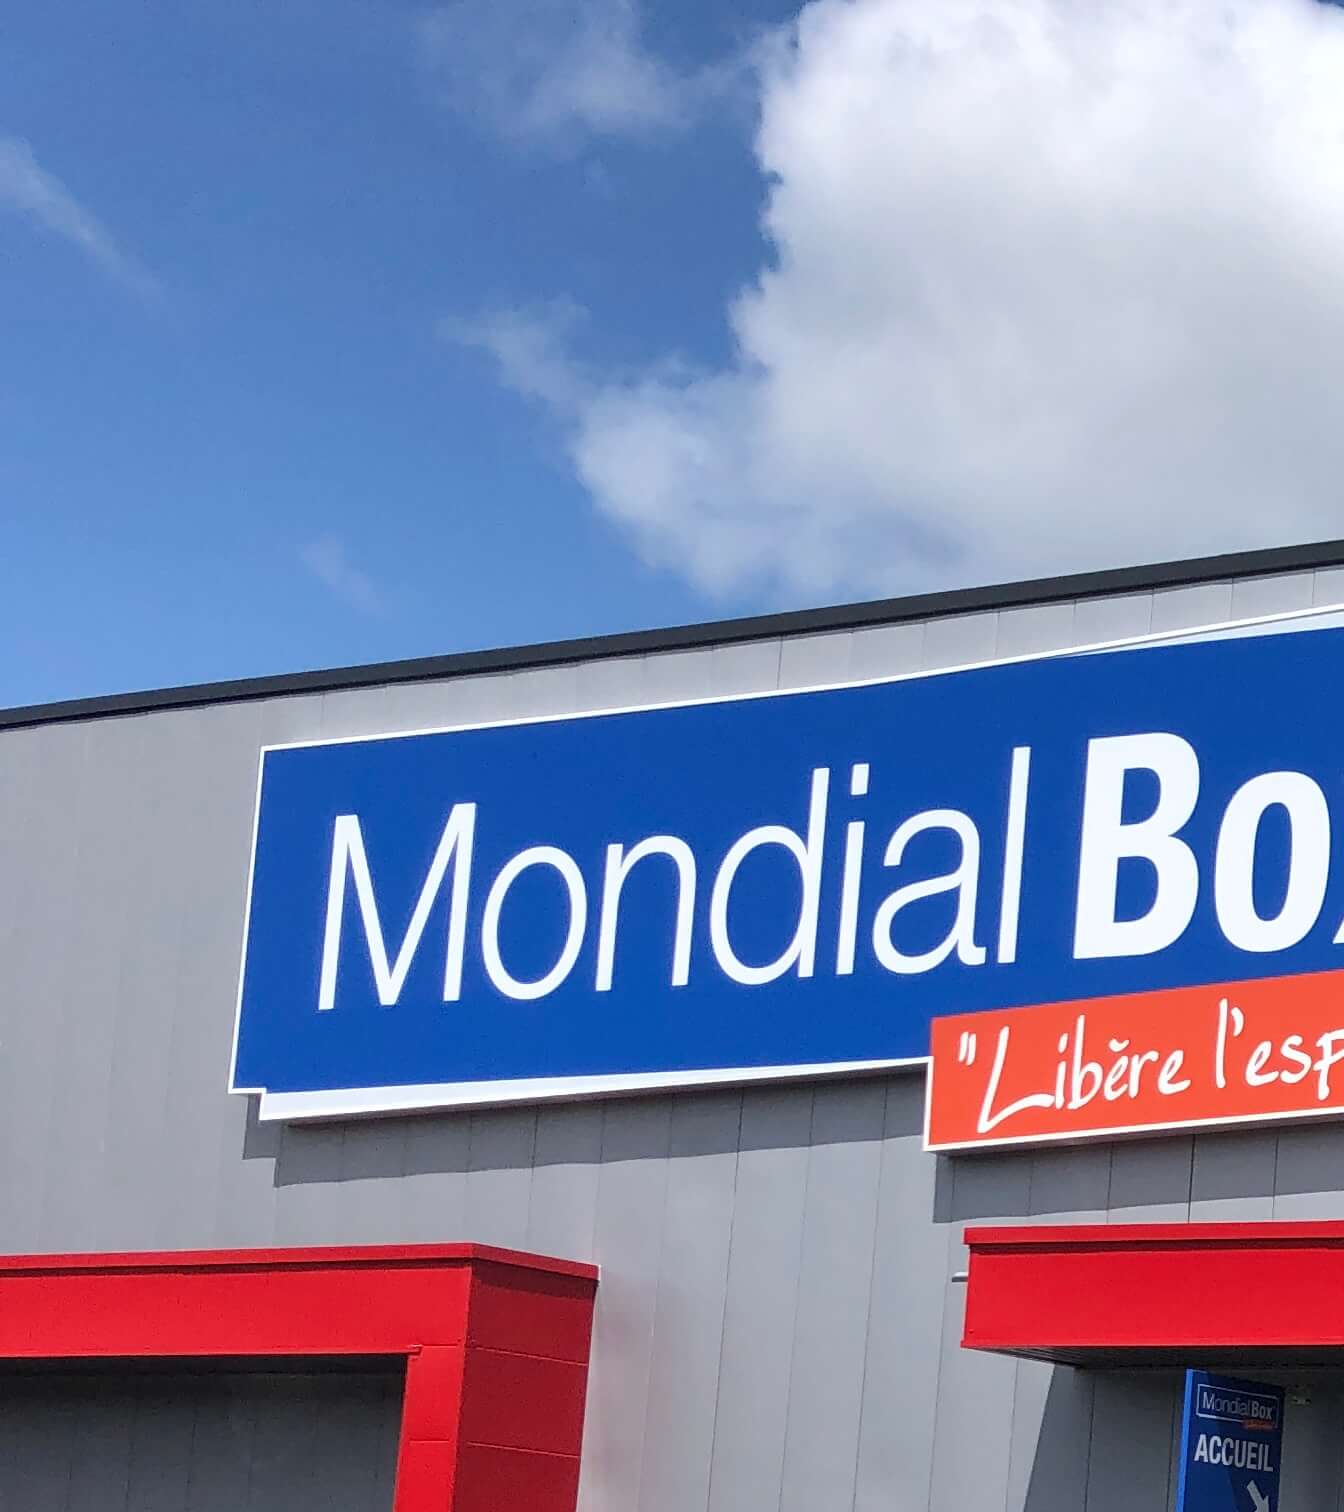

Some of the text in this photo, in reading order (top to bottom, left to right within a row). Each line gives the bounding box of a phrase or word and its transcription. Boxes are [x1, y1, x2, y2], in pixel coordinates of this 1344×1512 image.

[319, 745, 1031, 1010] Mondial
[1202, 1391, 1273, 1420] Mondial Box
[1194, 1433, 1274, 1472] ACCUEIL
